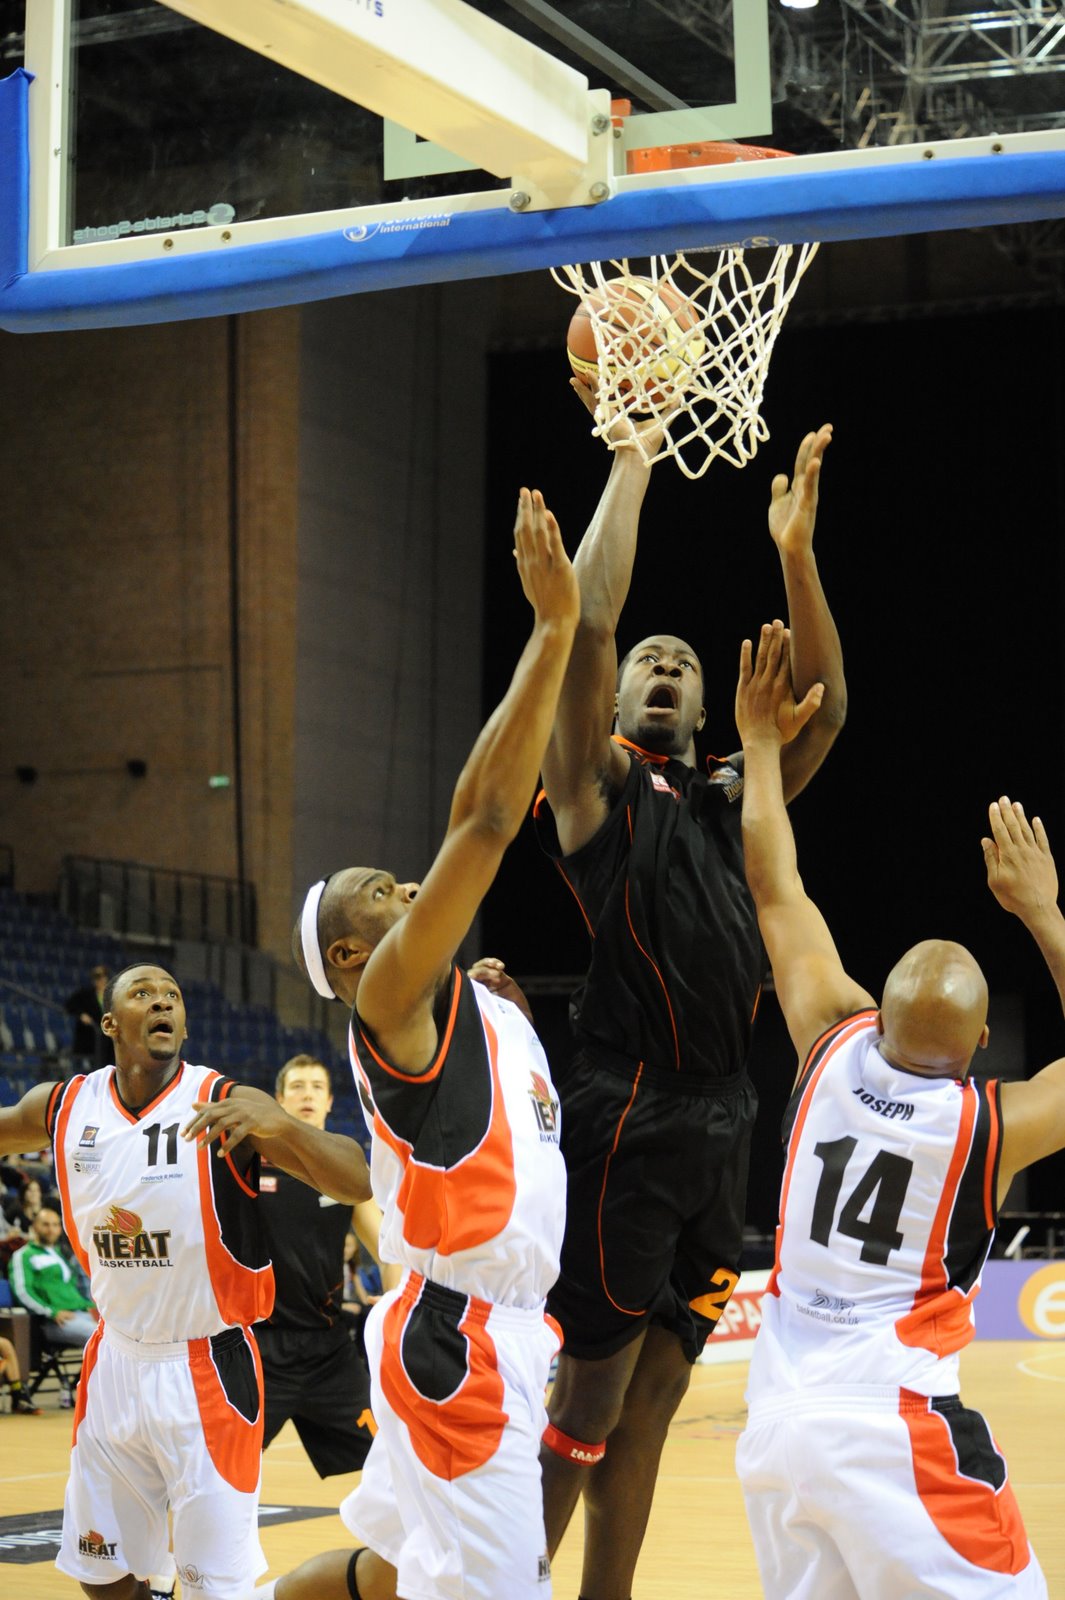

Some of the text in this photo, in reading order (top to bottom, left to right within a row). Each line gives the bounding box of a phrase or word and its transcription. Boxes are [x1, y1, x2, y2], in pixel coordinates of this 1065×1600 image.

[852, 1087, 914, 1121] JOSEPH
[142, 1123, 180, 1166] 11
[810, 1136, 913, 1266] 14
[93, 1230, 171, 1259] HEAT
[99, 1259, 173, 1268] BASKETBALL
[689, 1267, 739, 1321] 2
[79, 1535, 117, 1557] HEAT
